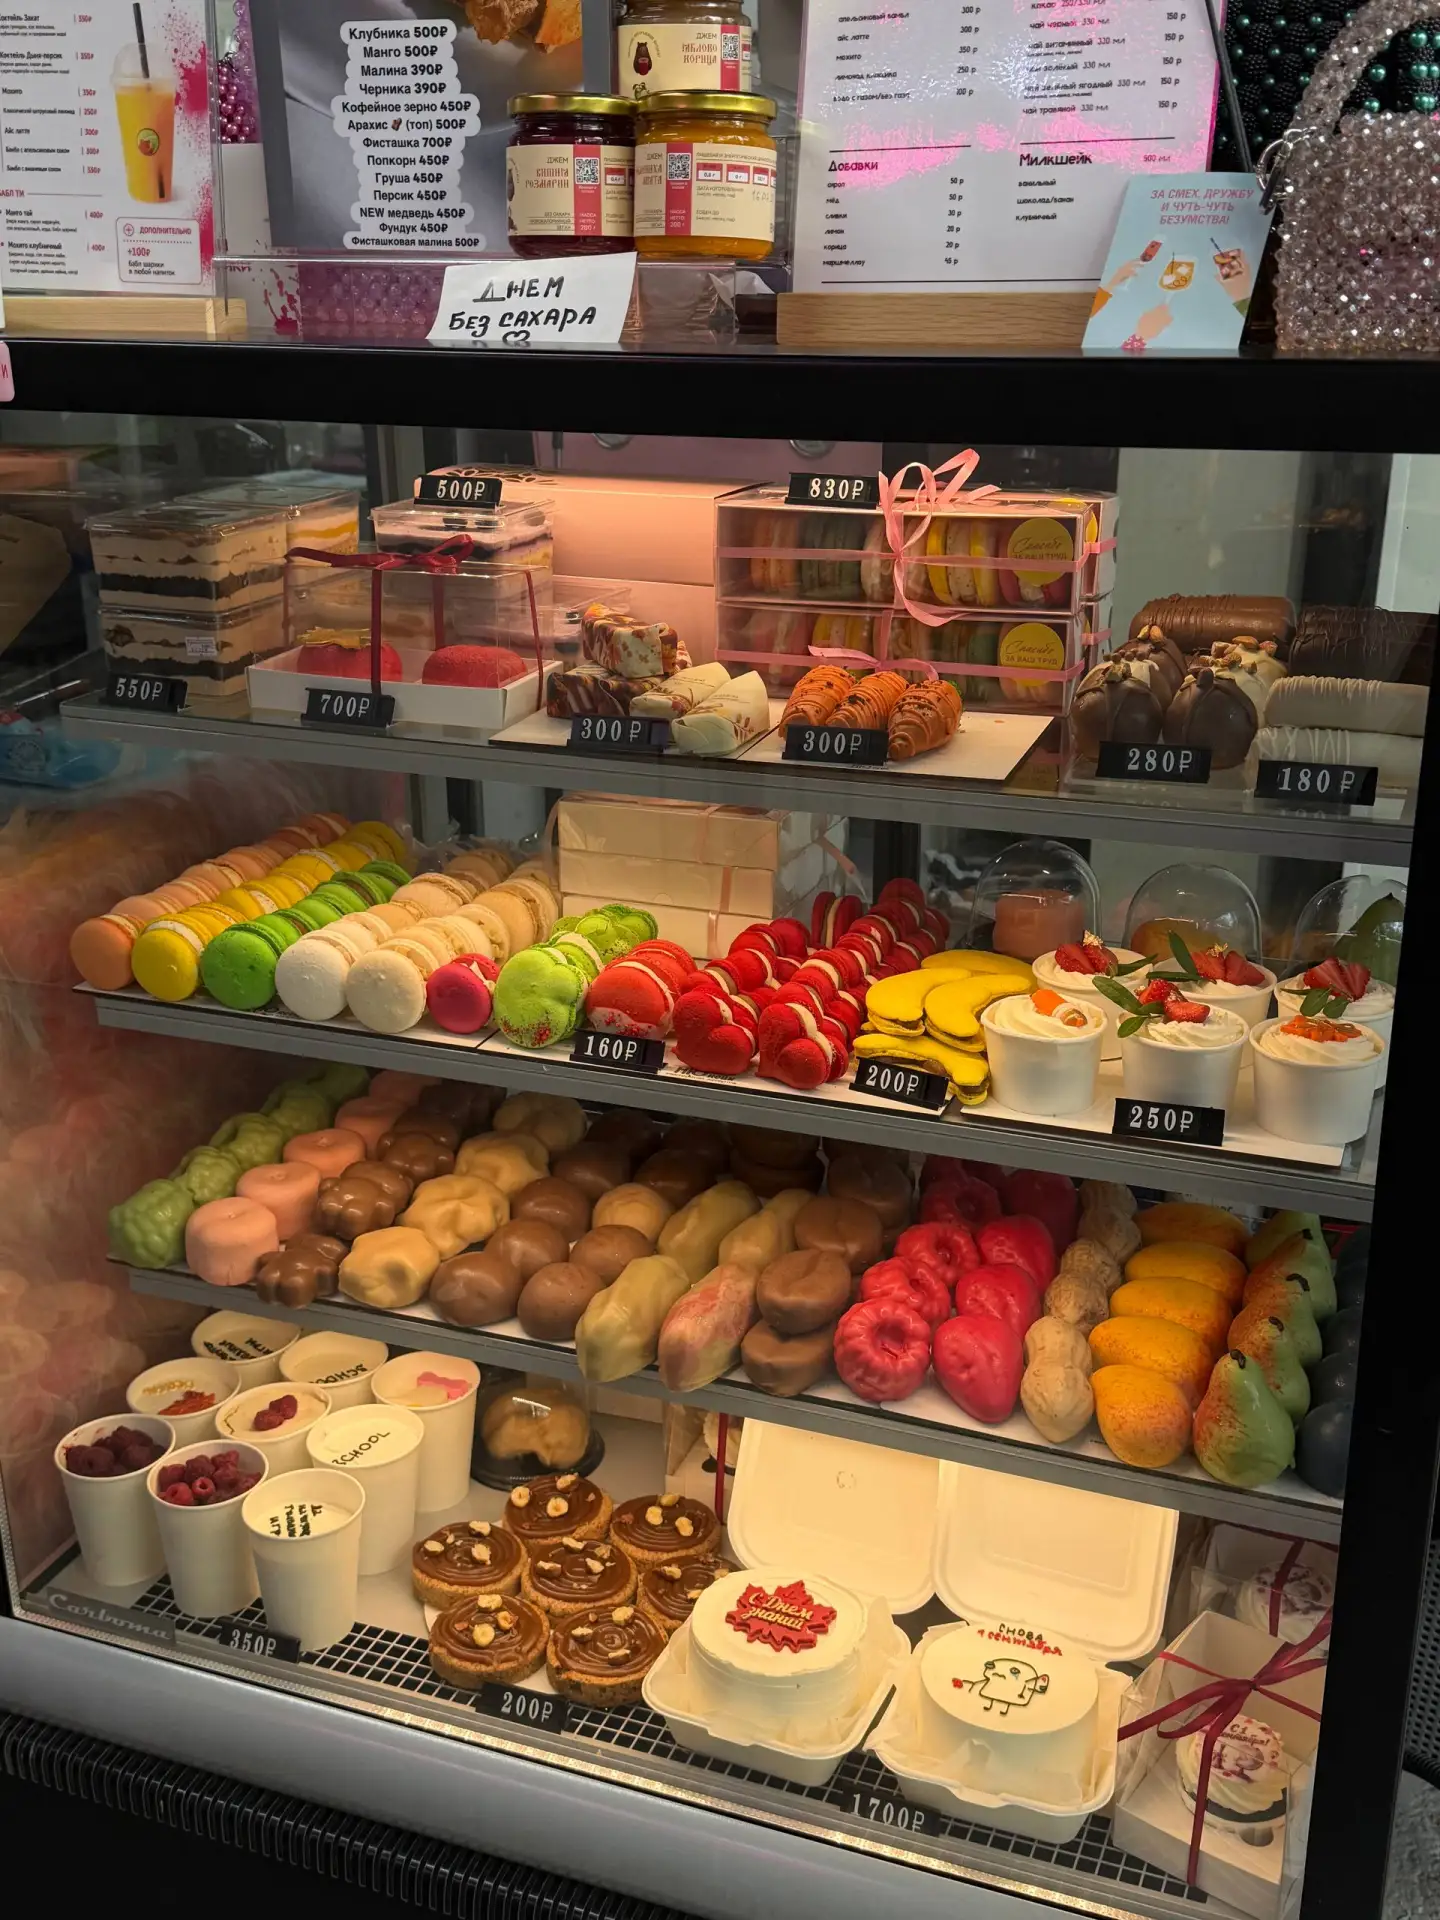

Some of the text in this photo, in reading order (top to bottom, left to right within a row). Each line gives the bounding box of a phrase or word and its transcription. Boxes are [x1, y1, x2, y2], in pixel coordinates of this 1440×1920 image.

[349, 27, 410, 42] Клубника
[364, 47, 401, 58] Манго
[684, 54, 717, 65] КОРИЦА
[361, 65, 408, 76] Малина
[1079, 80, 1113, 89] ягодный
[360, 84, 411, 97] Черника
[342, 102, 401, 114] Кофейное
[404, 103, 437, 114] зерно
[1040, 105, 1076, 115] травяной
[348, 120, 388, 132] Арахис
[406, 119, 433, 131] (топ)
[362, 138, 420, 148] Фисташка
[367, 155, 416, 168] Попкорн
[1019, 152, 1092, 166] Милкшейк
[828, 160, 878, 172] Добавки
[375, 173, 410, 185] Груша
[525, 179, 569, 188] РОЗМАРИН
[1018, 179, 1056, 187] ванильный
[374, 190, 414, 202] Персик
[1151, 189, 1165, 199] ЗА
[1203, 189, 1254, 199] ДРУЖБУ
[1161, 202, 1235, 212] И ЧУТЬ-ЧУТЬ
[360, 208, 384, 218] NEW
[388, 209, 434, 219] медведь
[1016, 213, 1057, 221] клубничный
[1160, 215, 1230, 225] БЕЗУМСТВА!
[140, 226, 192, 235] ДОПОЛНИТЕЛЬНО
[379, 223, 417, 234] Фундук
[352, 237, 416, 246] Фисташковая
[418, 238, 452, 246] малина
[472, 276, 565, 302] ДЖЕМ
[449, 306, 596, 338] БЕЗ САХАРА
[332, 1432, 391, 1465] SCHOOL
[749, 1593, 813, 1620] С Днем
[50, 1594, 170, 1639] Carboma
[741, 1607, 805, 1630] знаний
[999, 1623, 1043, 1642] СНОВА
